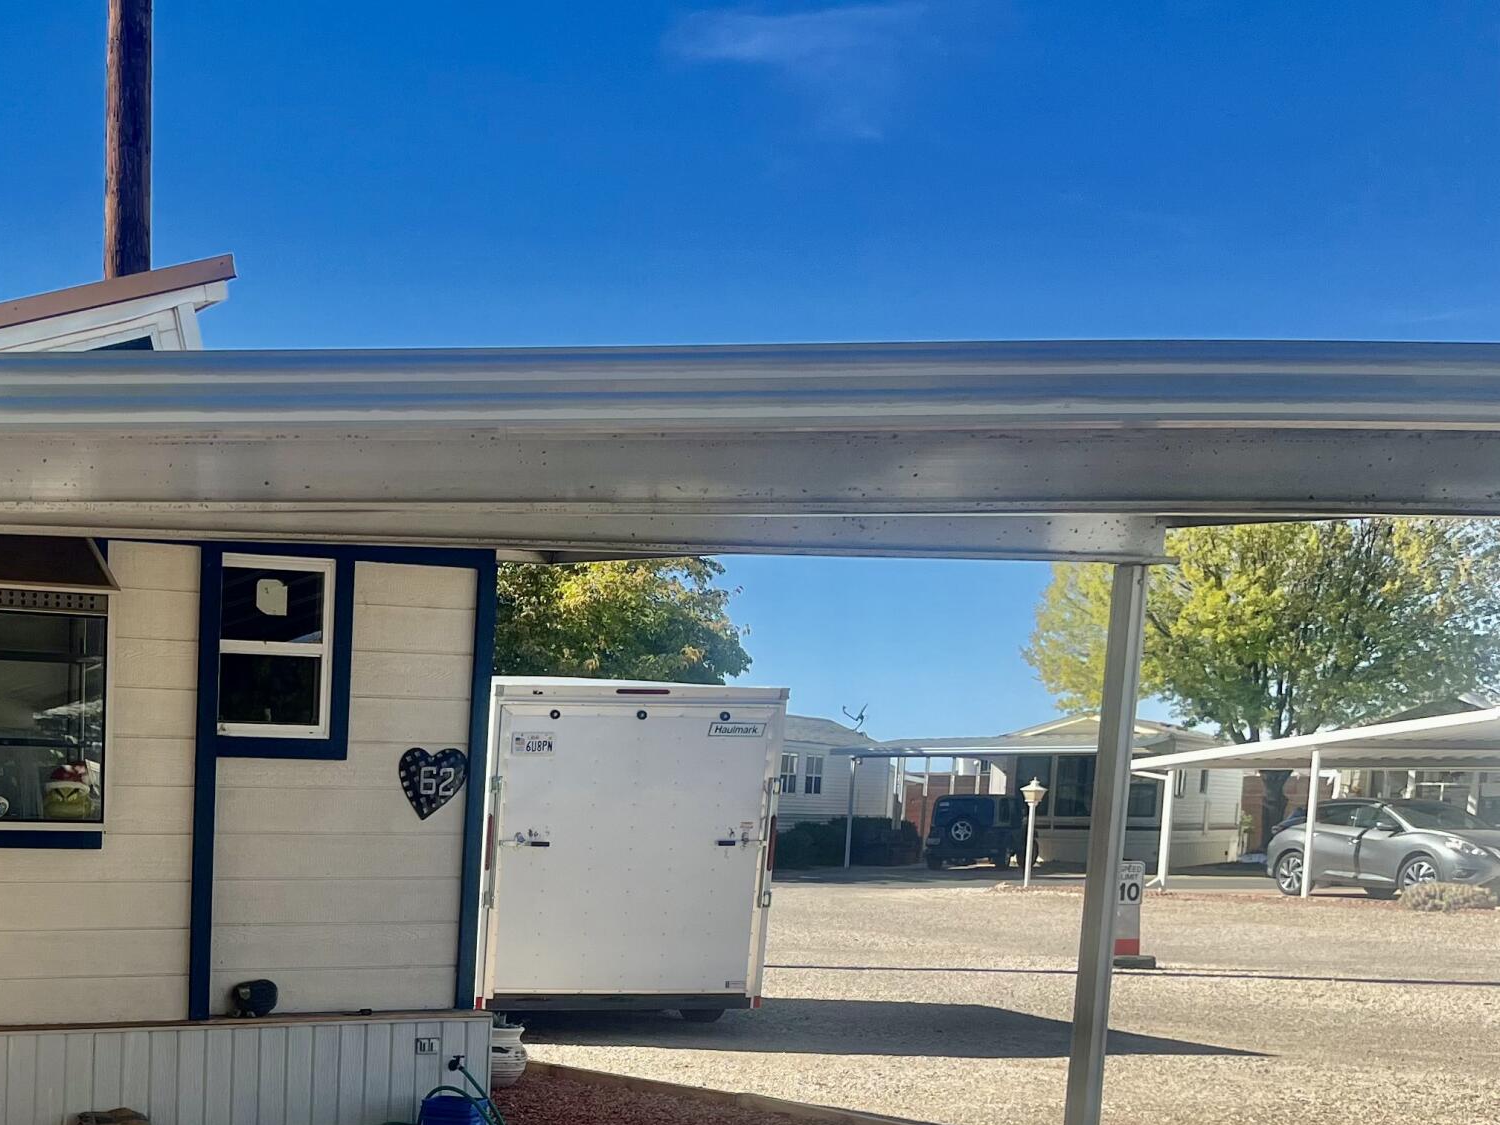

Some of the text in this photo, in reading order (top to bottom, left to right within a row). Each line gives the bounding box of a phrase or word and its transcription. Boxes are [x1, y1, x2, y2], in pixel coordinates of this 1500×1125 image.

[714, 725, 758, 734] Haulmark
[420, 766, 456, 797] 62
[1119, 882, 1140, 901] 10
